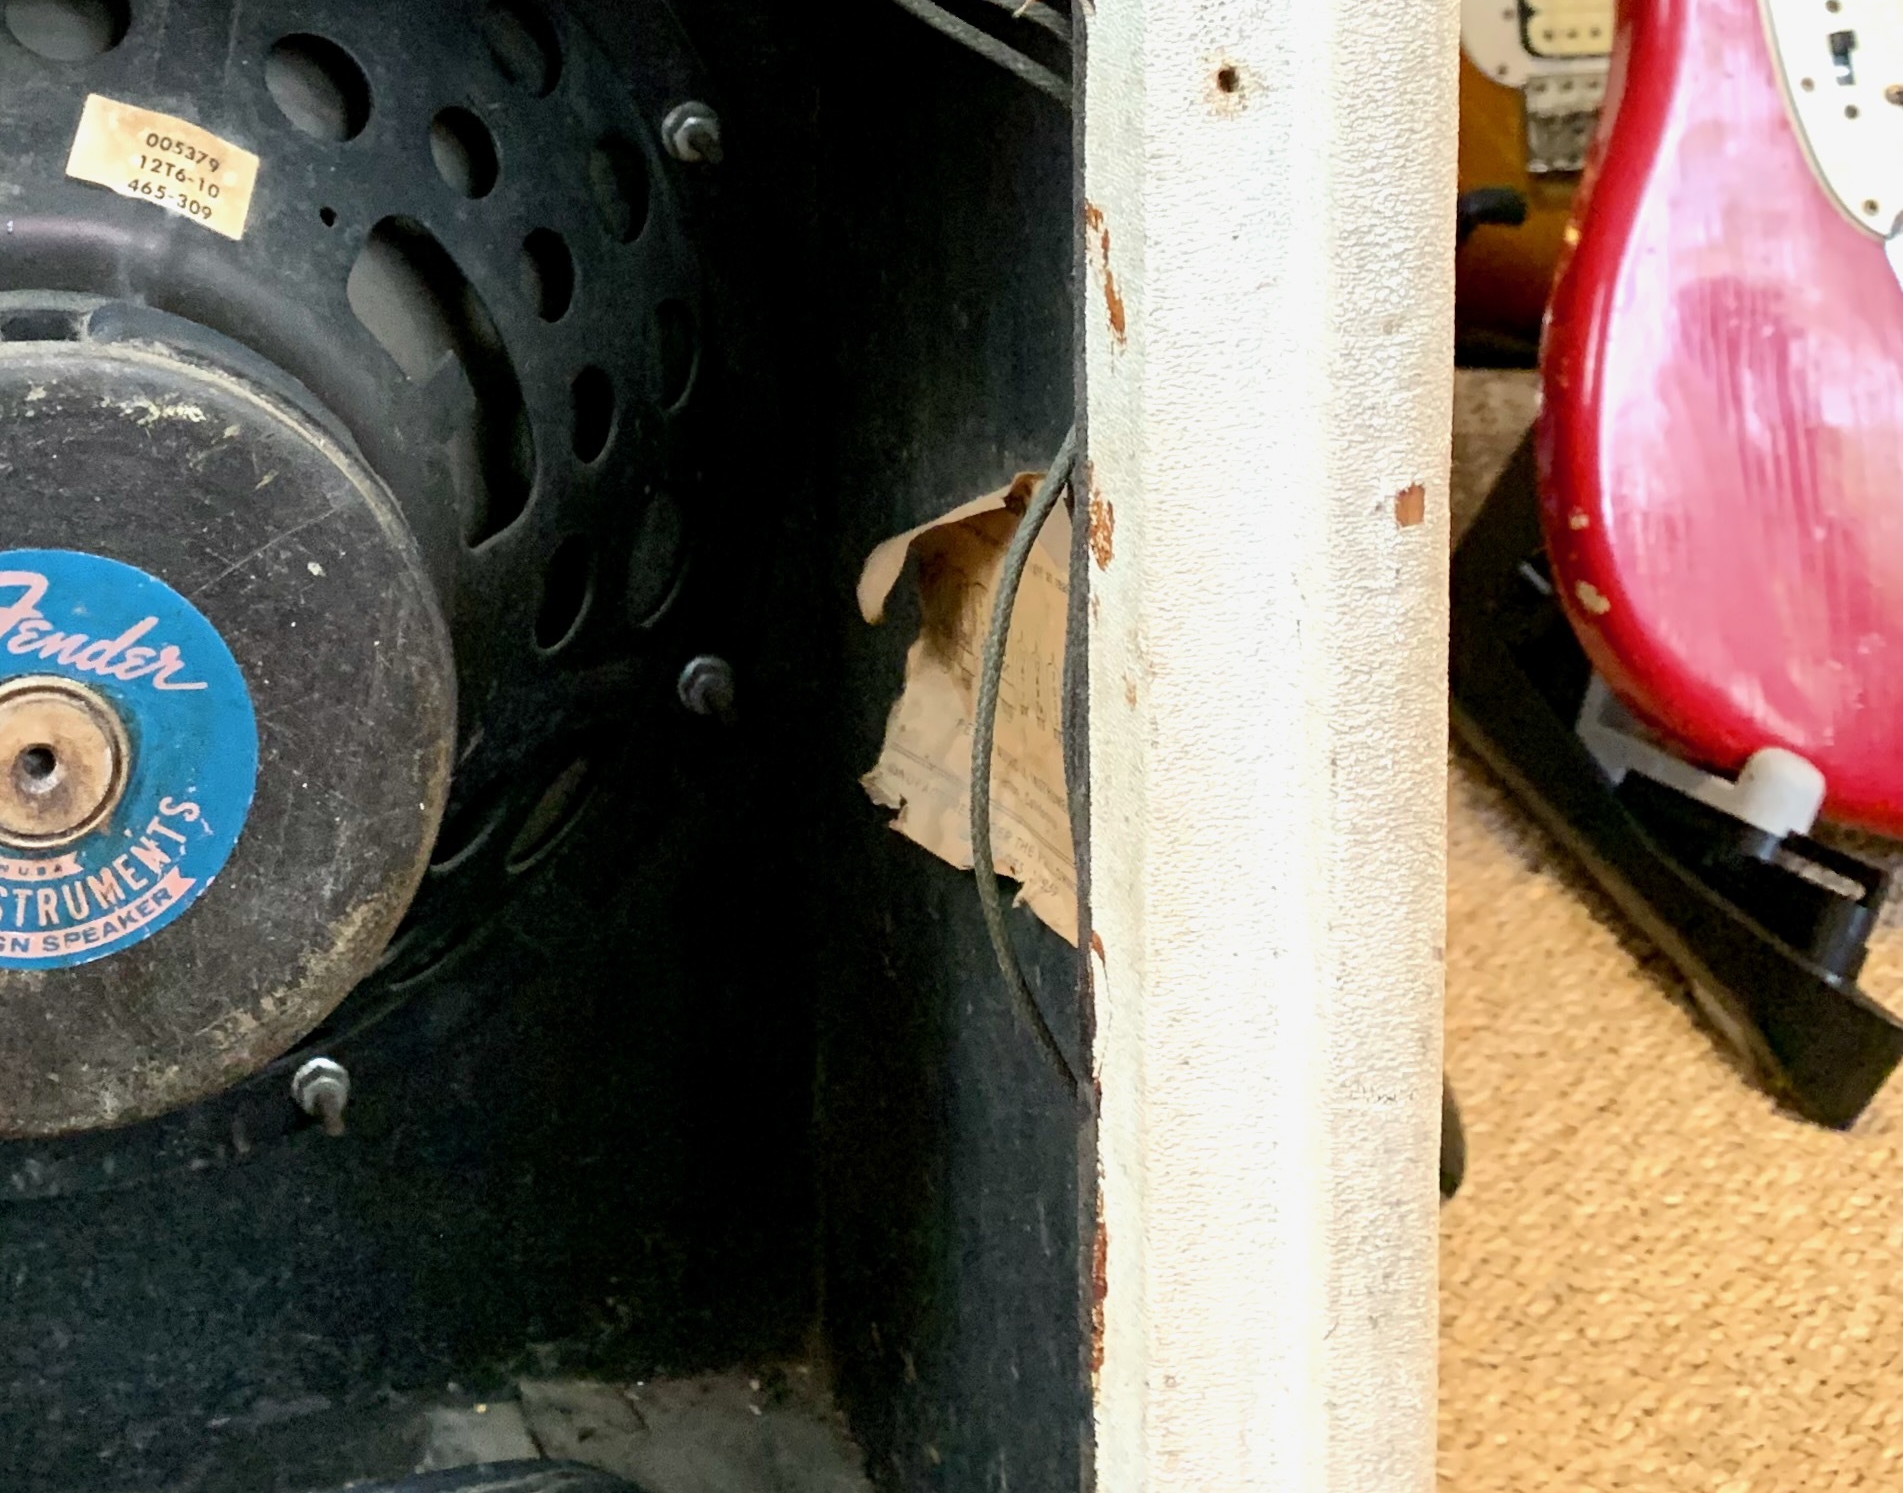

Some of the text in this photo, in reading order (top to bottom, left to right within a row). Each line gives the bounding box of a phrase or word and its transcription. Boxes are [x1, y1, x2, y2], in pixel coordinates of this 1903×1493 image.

[146, 132, 222, 173] 005379
[139, 154, 221, 199] 12T6-10
[127, 178, 213, 220] 465-309
[41, 886, 174, 953] SPEAKER
